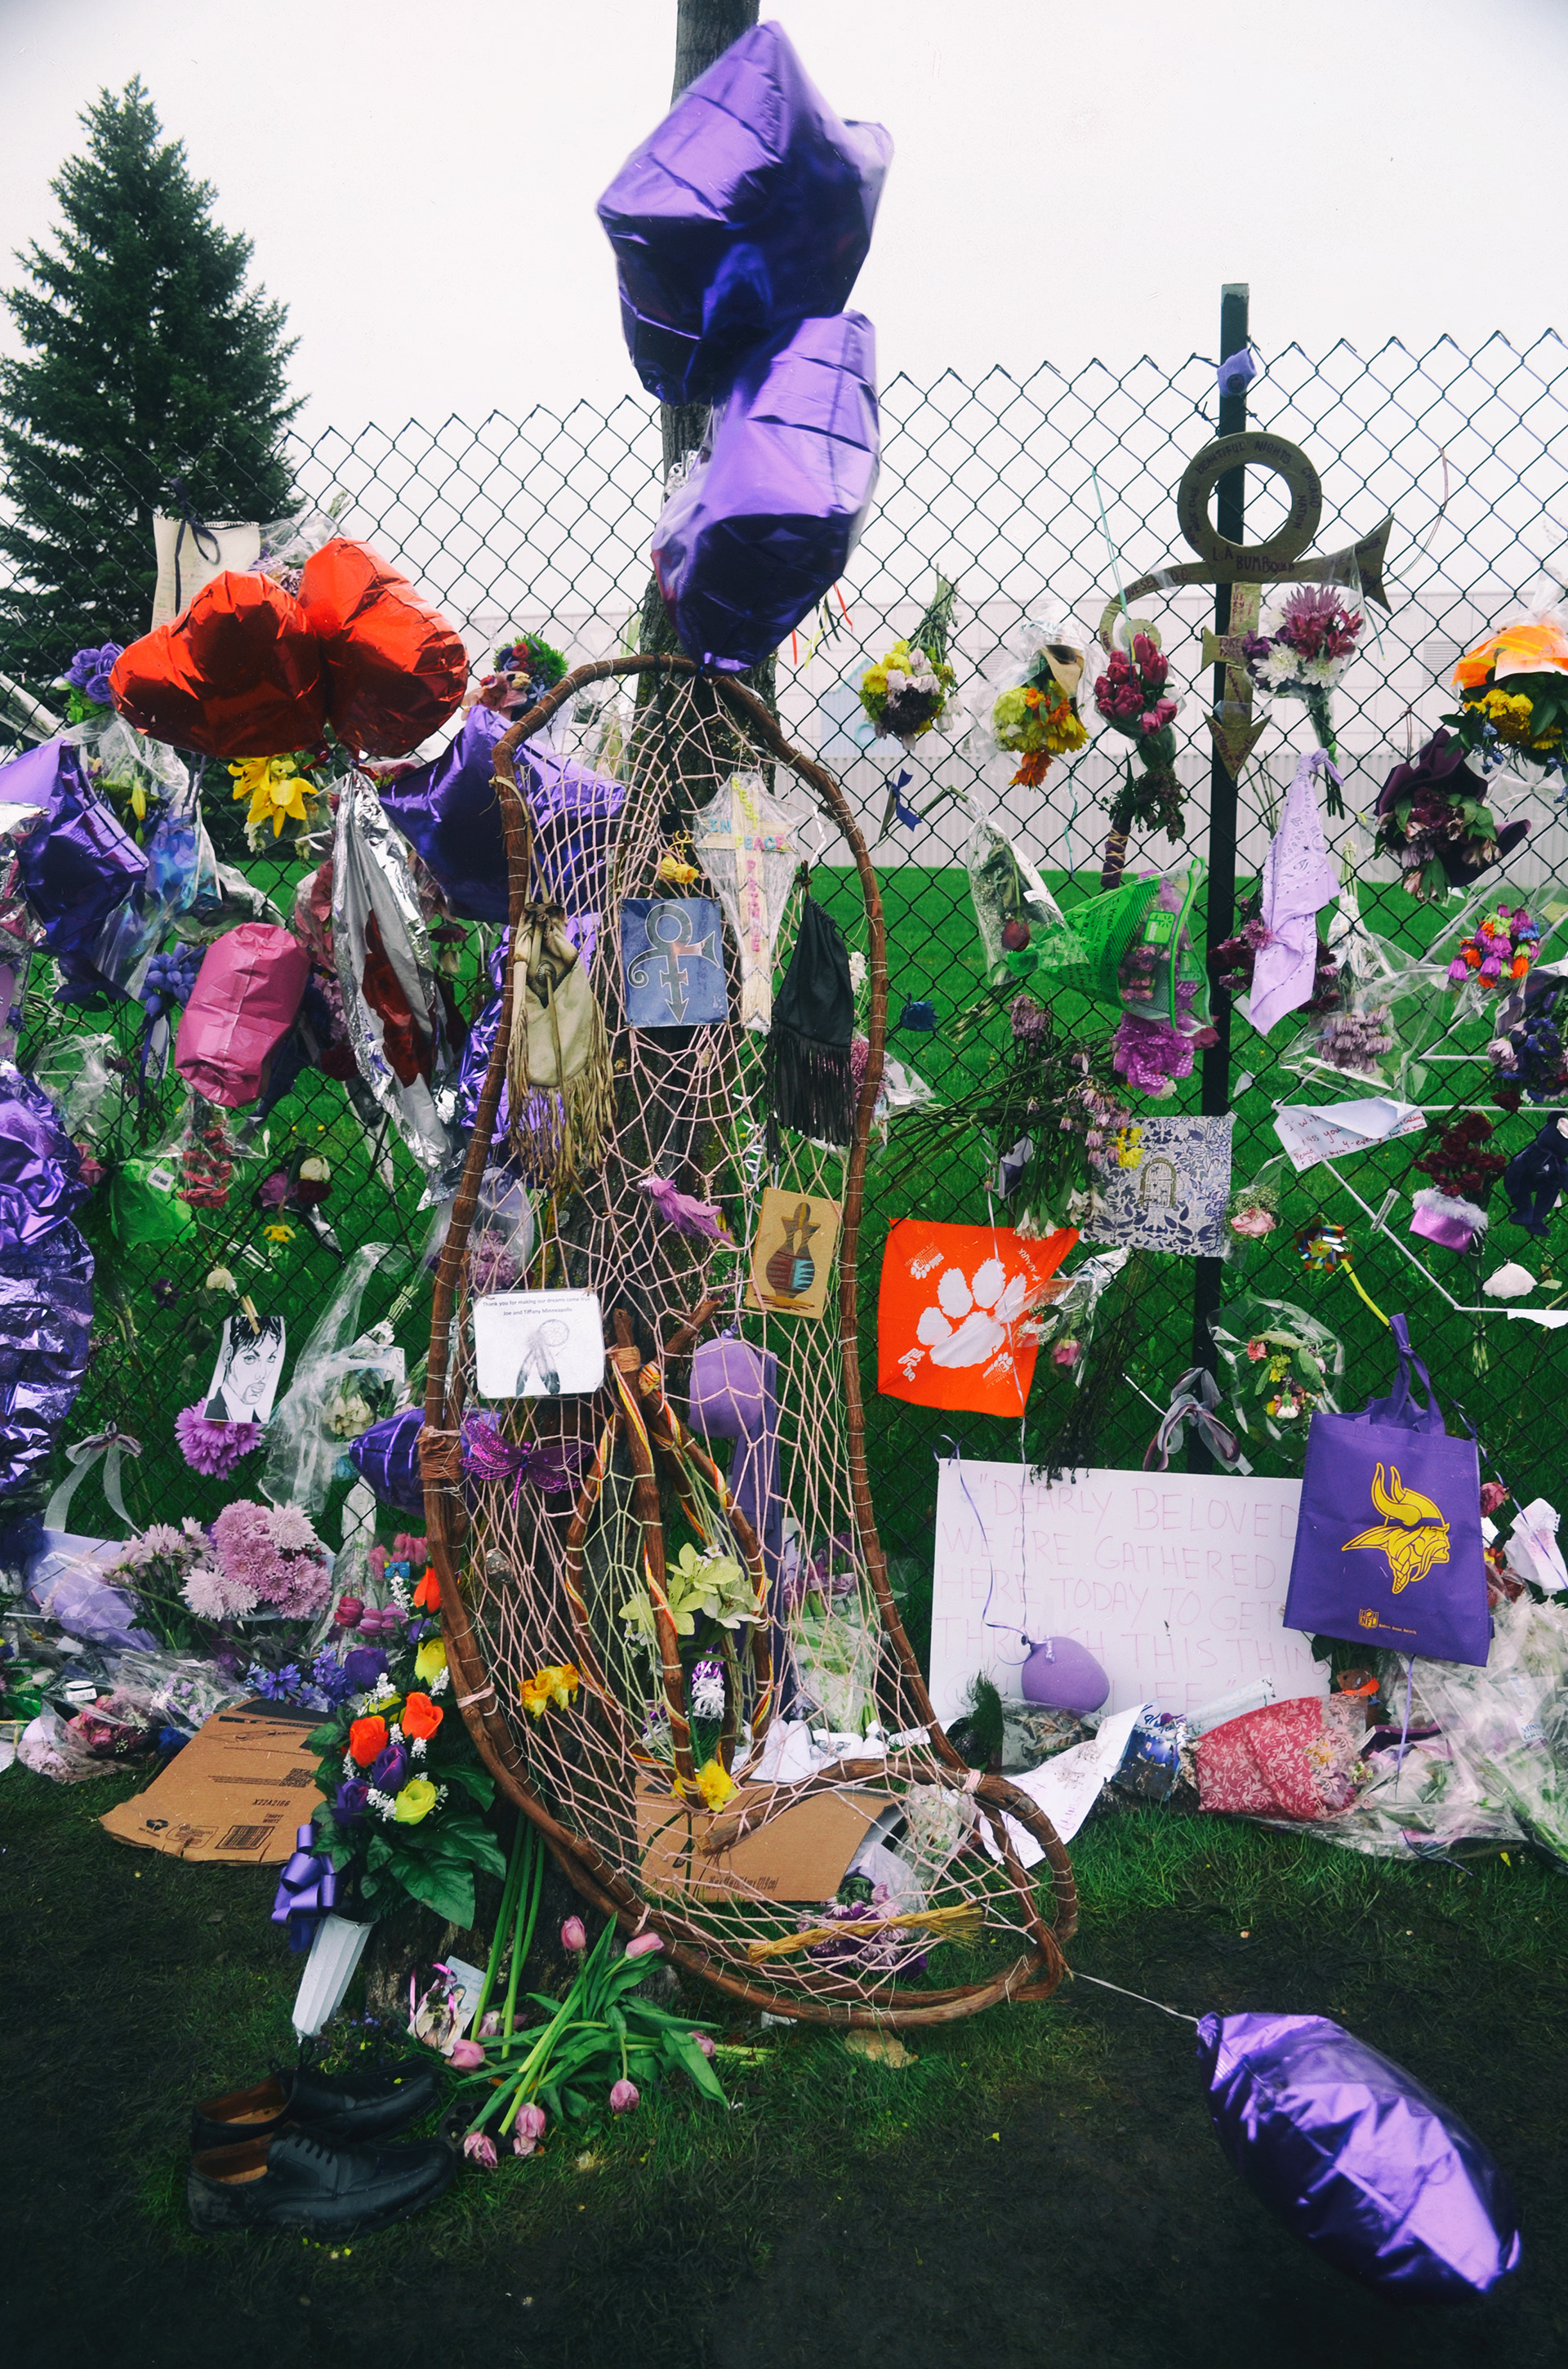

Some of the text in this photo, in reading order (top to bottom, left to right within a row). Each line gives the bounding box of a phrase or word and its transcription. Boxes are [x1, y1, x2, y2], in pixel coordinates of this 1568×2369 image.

[708, 818, 732, 833] IN
[731, 777, 760, 828] REST
[1132, 1487, 1299, 1540] BELOVED
[942, 1522, 1276, 1590] WE ARE GATHERED
[941, 1565, 1040, 1605] HERE
[1049, 1577, 1148, 1628] TODAY
[1361, 1615, 1378, 1628] NFL
[1120, 1633, 1218, 1669] THIS
[1226, 1638, 1328, 1676] THING
